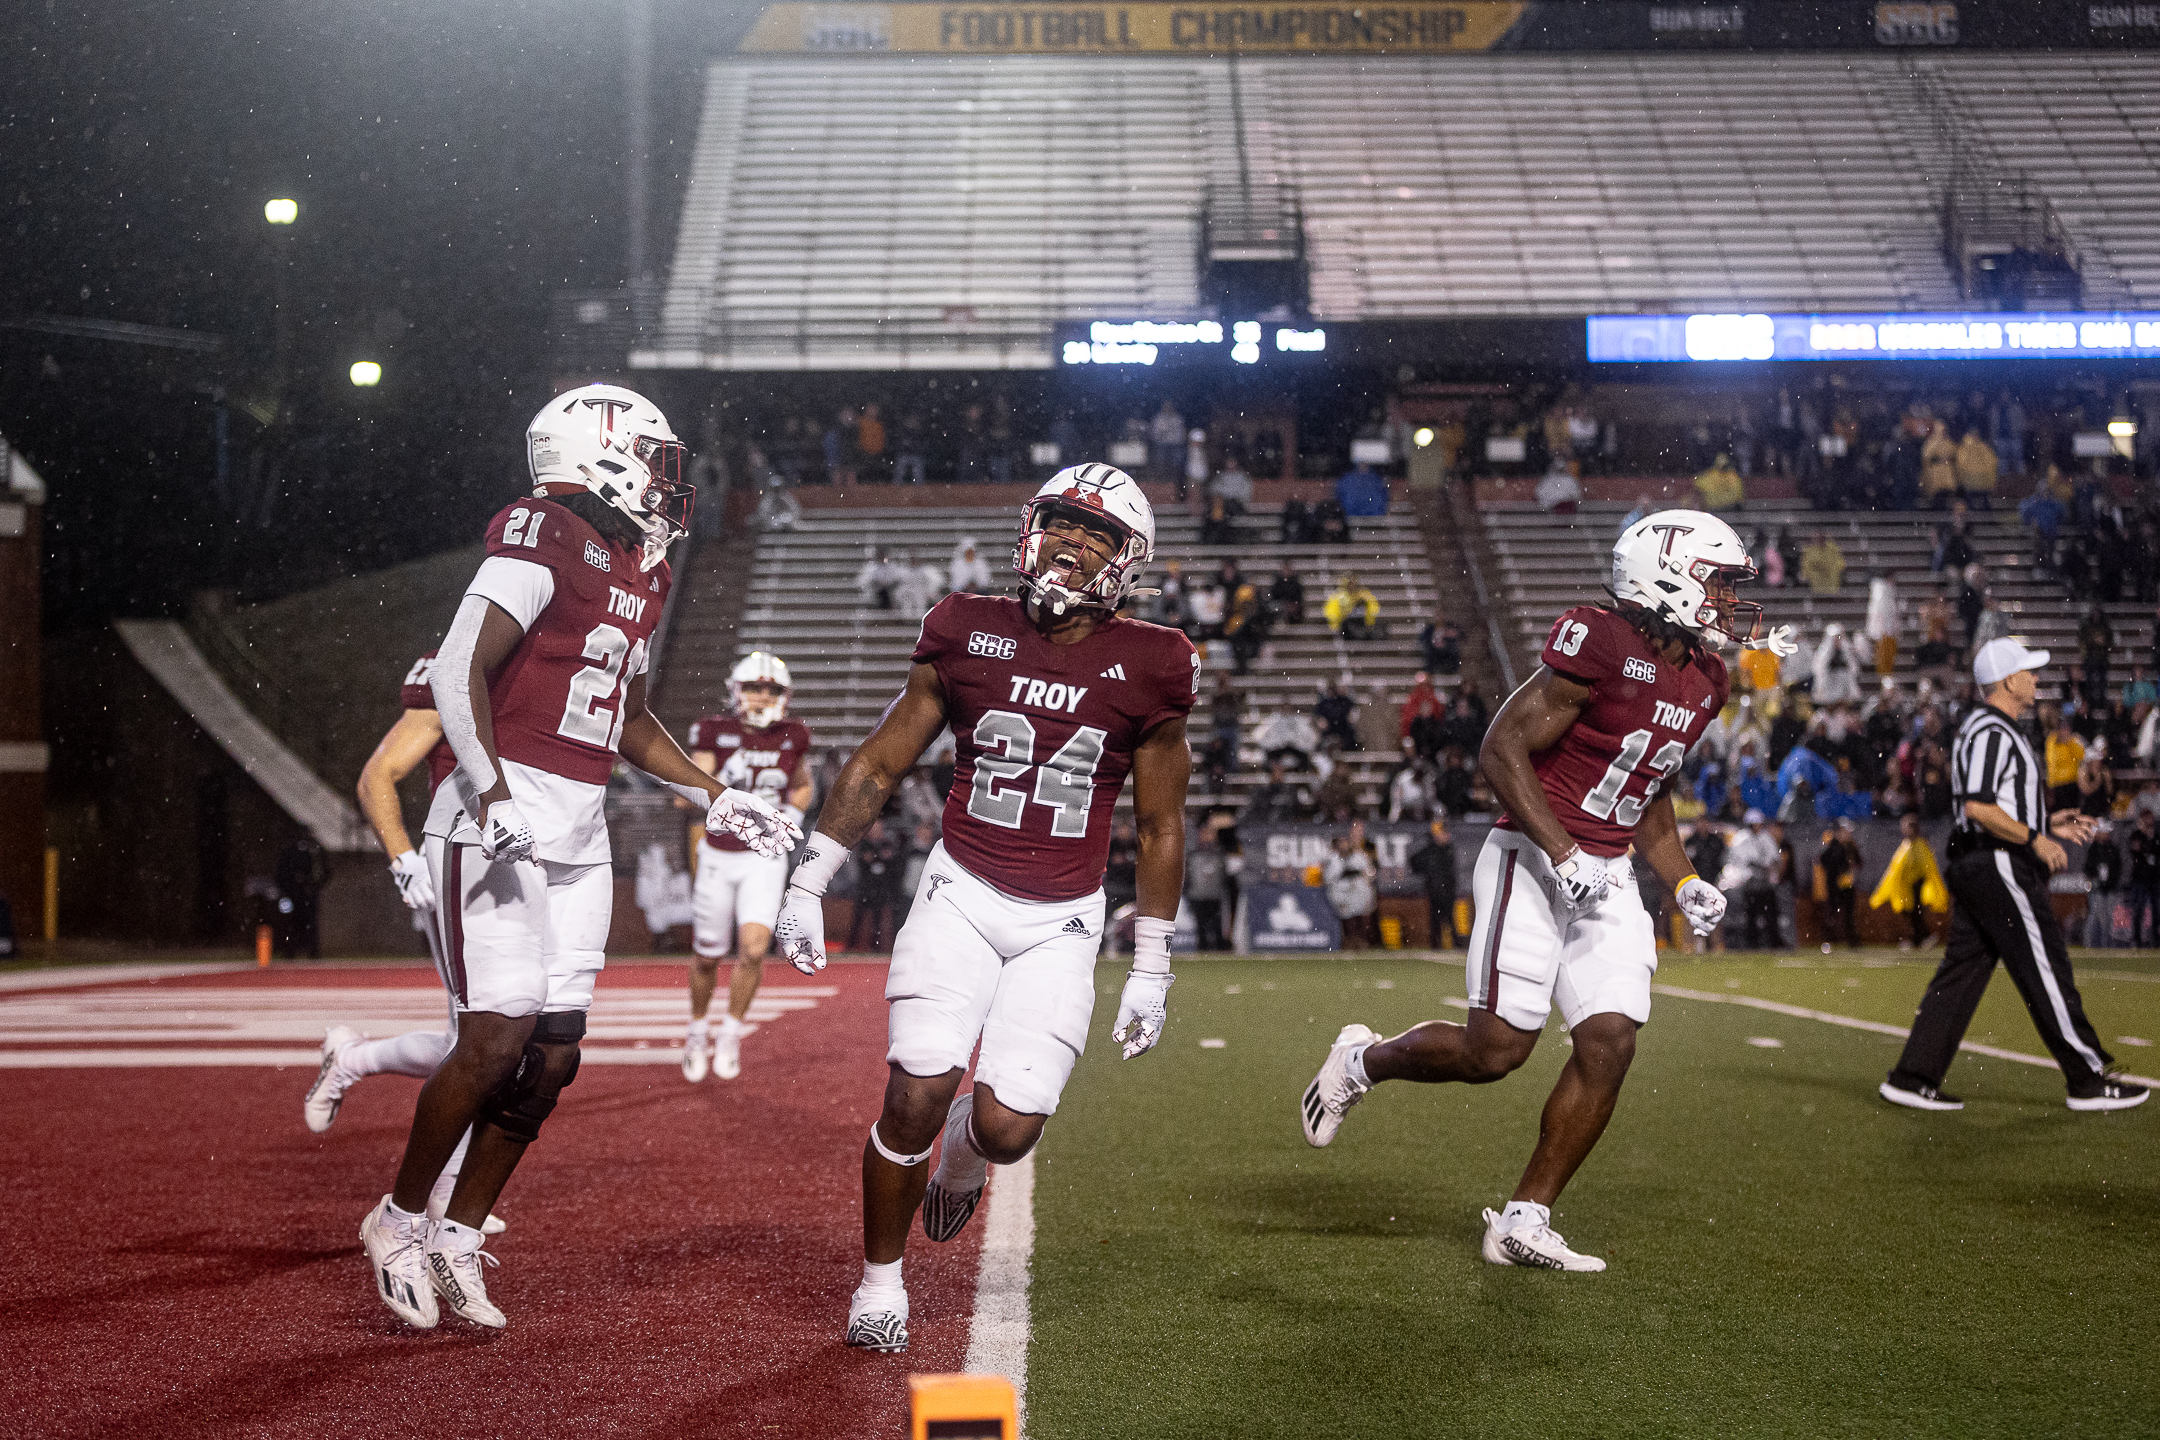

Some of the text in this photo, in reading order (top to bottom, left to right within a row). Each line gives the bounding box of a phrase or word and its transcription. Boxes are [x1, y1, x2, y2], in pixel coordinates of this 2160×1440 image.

[939, 10, 1140, 46] FOOTBALL
[1171, 9, 1466, 45] CHAMPIONSHIP
[2089, 5, 2132, 27] SUN
[502, 507, 546, 548] 21
[584, 539, 611, 573] SBC
[607, 585, 647, 624] TROY
[967, 631, 1017, 660] SBC
[1552, 618, 1589, 657] 13
[1622, 656, 1656, 683] SBC
[1008, 675, 1088, 713] TROY
[1651, 700, 1697, 733] TROY
[967, 709, 1108, 838] 24
[1580, 728, 1686, 827] 13
[1062, 926, 1090, 936] adidas
